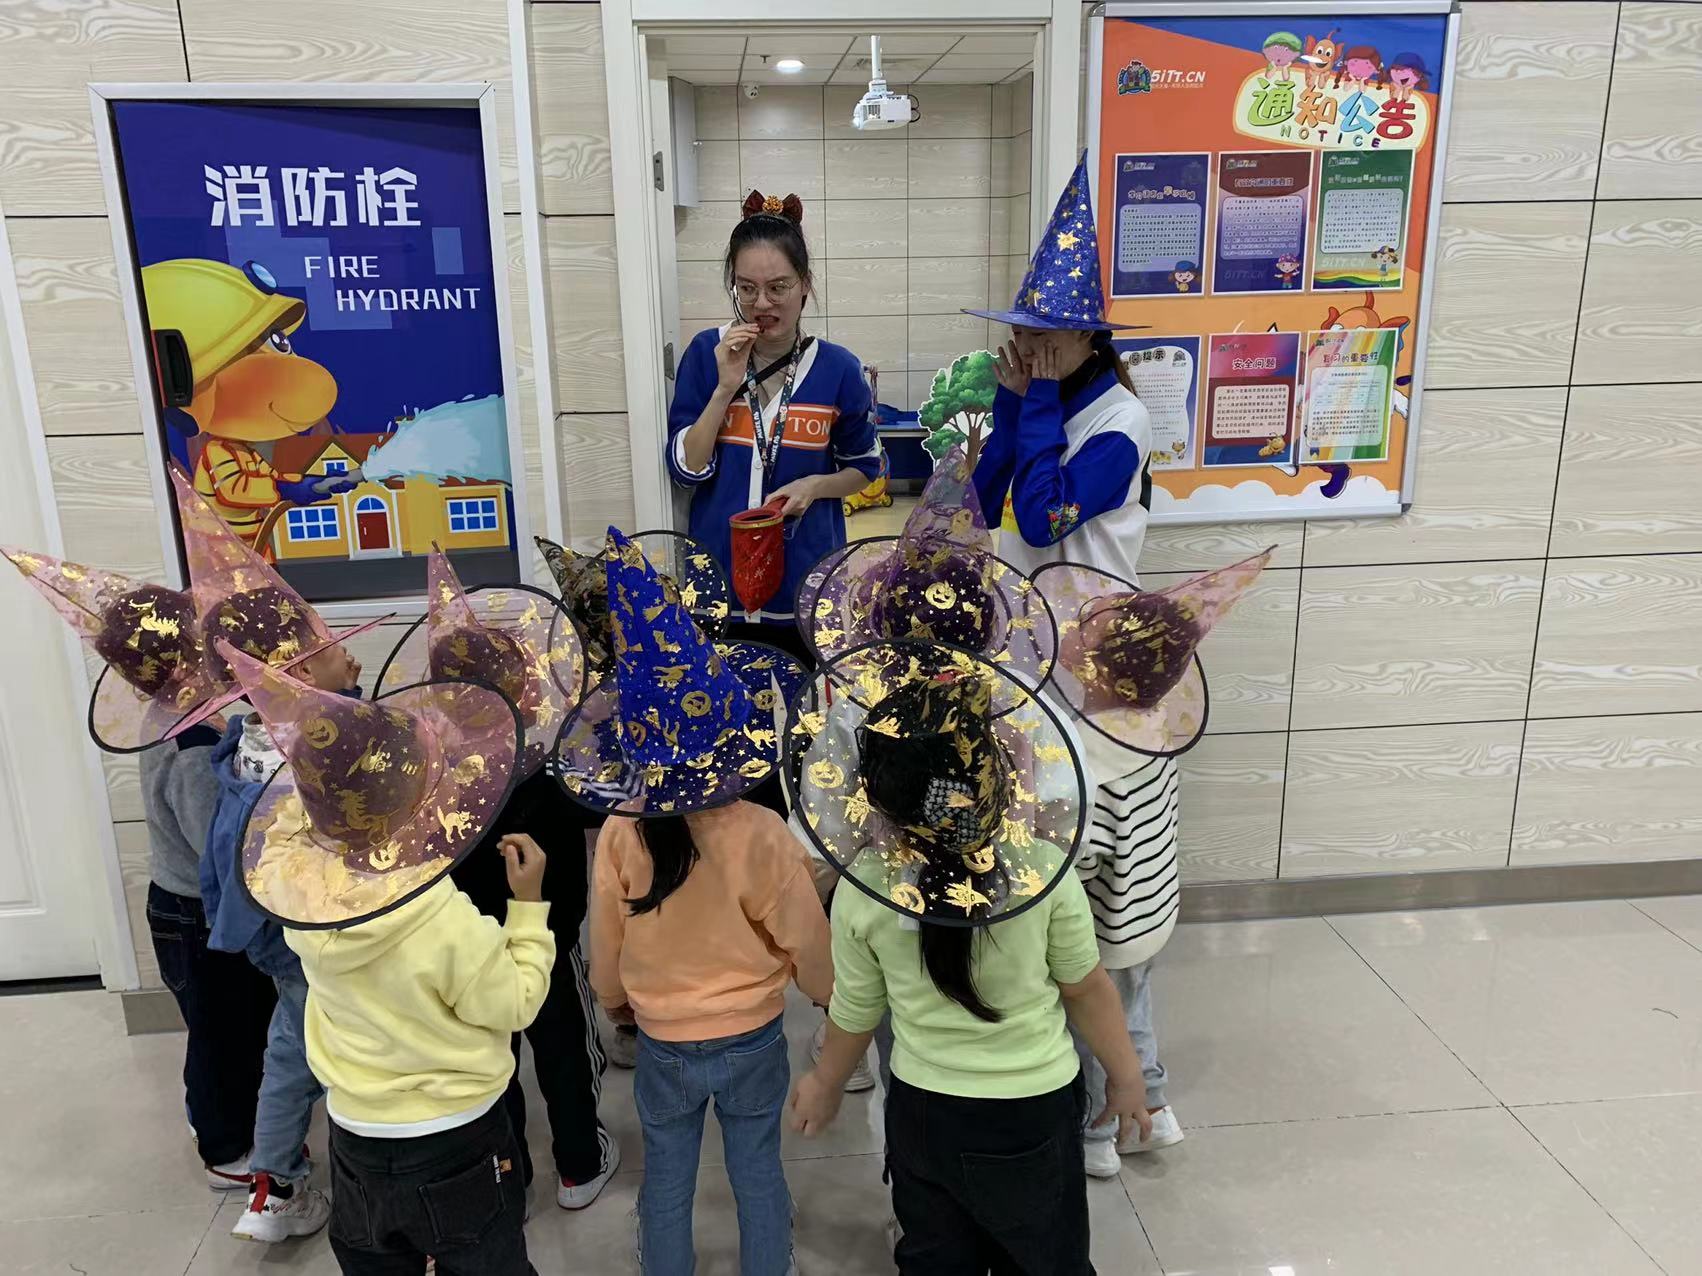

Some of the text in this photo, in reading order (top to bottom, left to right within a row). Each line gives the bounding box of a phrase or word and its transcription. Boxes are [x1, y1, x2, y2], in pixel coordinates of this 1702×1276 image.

[1248, 77, 1416, 140] 通知公告
[1280, 125, 1381, 149] NOTICE
[204, 164, 422, 227] 消防栓
[304, 255, 381, 279] FIRE
[336, 287, 481, 312] HYDRANT
[1232, 356, 1277, 370] 安全问题
